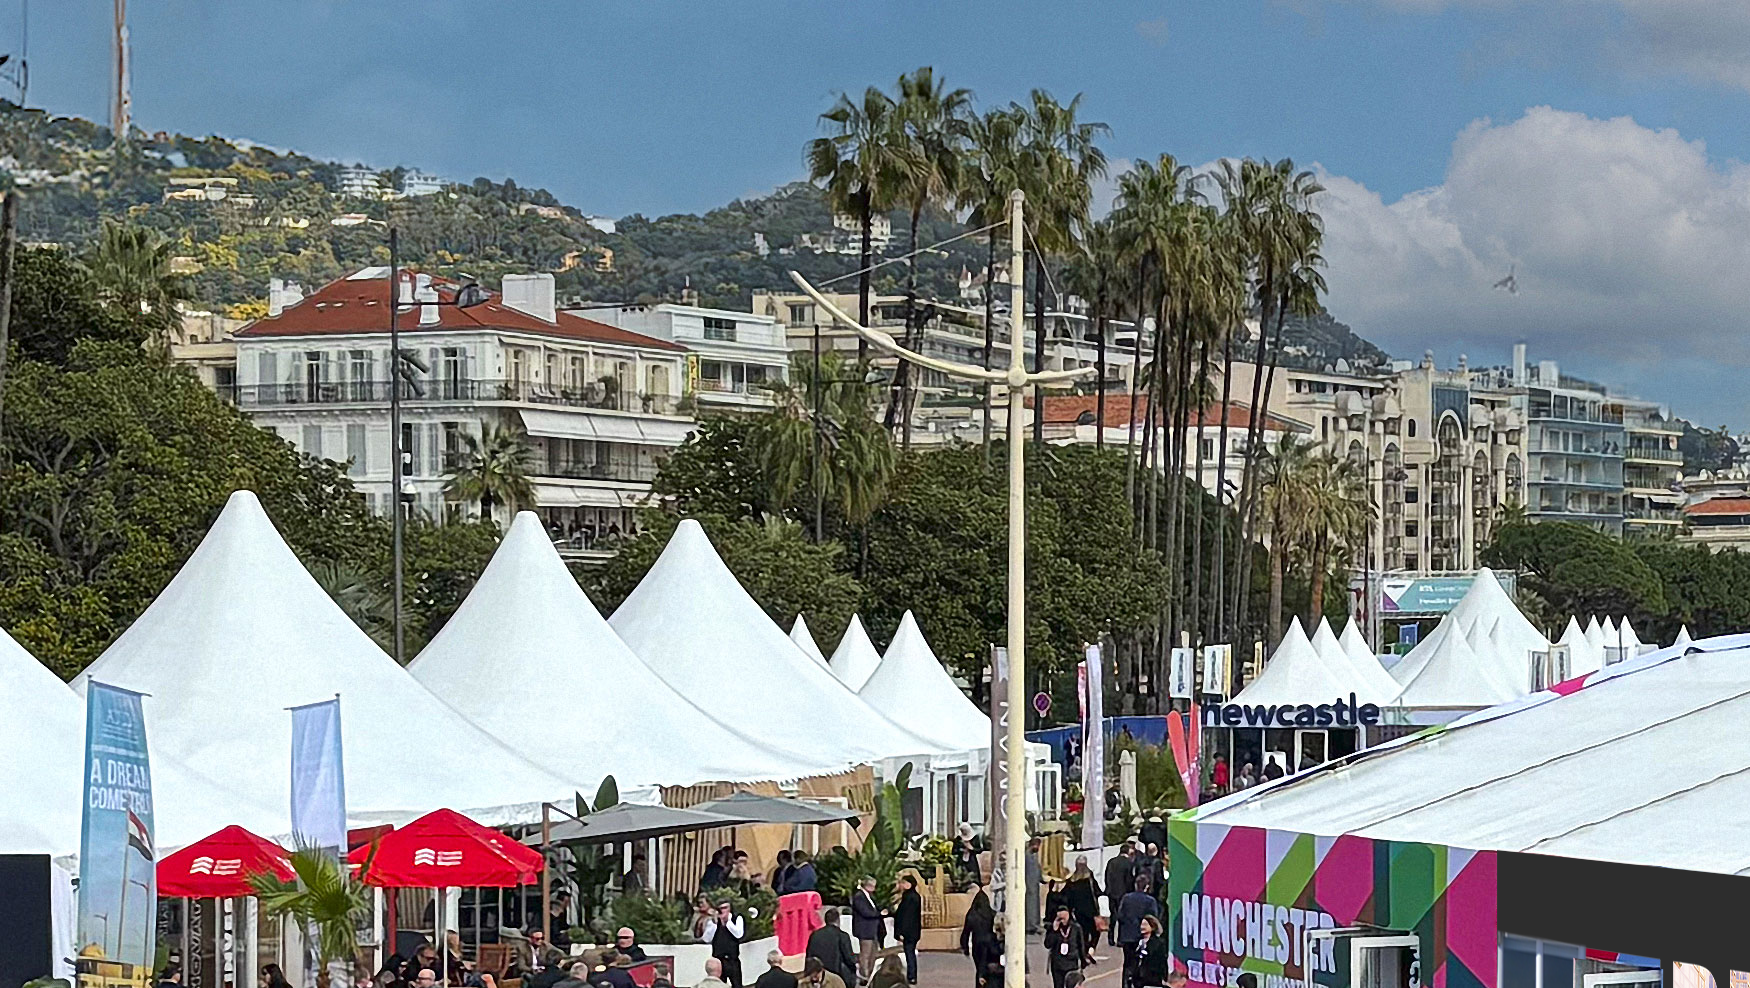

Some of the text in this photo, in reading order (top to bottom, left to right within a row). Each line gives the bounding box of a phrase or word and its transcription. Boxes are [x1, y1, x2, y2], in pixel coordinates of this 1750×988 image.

[1201, 692, 1380, 726] newcastle
[90, 758, 102, 784] A
[89, 786, 128, 812] COME
[1182, 892, 1336, 974] MANCHESTER
